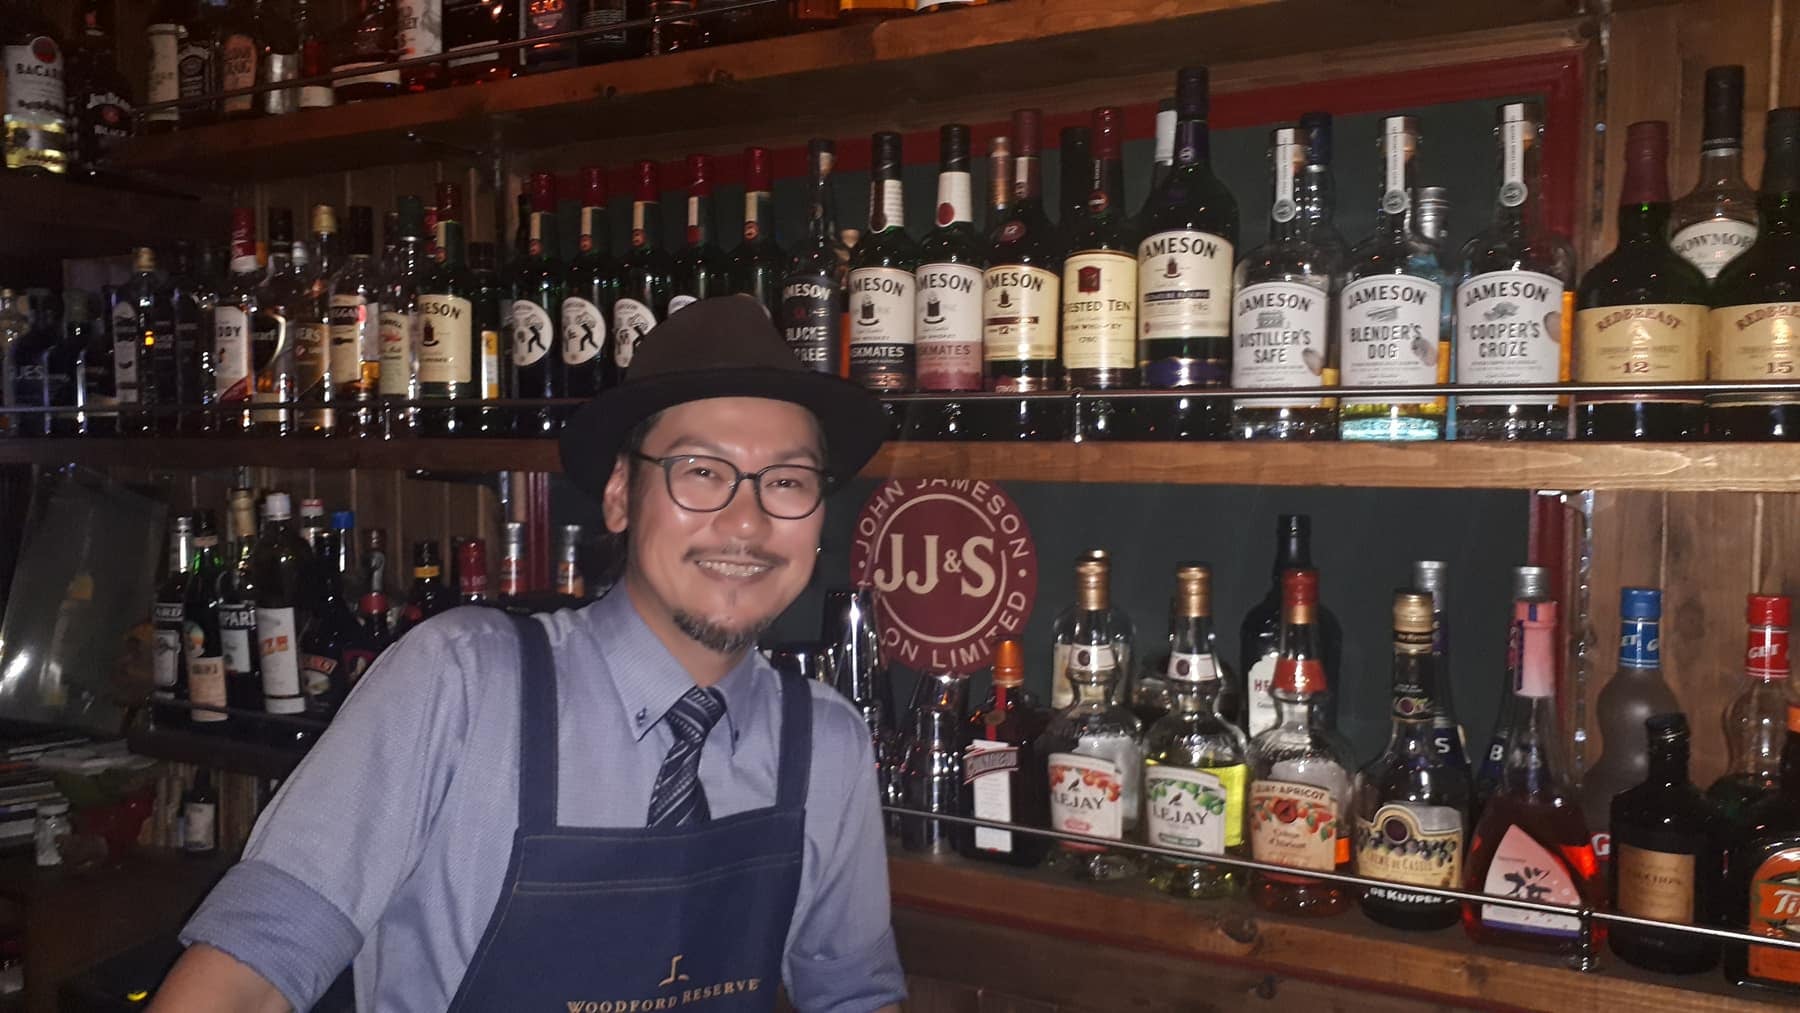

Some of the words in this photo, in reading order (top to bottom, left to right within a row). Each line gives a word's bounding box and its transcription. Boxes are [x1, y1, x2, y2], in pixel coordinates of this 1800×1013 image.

[1106, 299, 1131, 312] TEN
[1239, 293, 1312, 316] JAMESON
[1347, 285, 1428, 309] JAMESON
[1464, 281, 1550, 307] JAMESON
[1596, 307, 1682, 331] REDBREAST
[1351, 323, 1423, 343] BLENDER'S
[1254, 349, 1288, 364] SAFE
[1367, 343, 1400, 360] DOG
[1478, 341, 1529, 358] CROZE
[1622, 361, 1650, 374] 12
[1768, 360, 1794, 374] 15
[856, 480, 905, 555] JOHN
[873, 533, 996, 598] JJ&S
[931, 591, 1027, 670] LIMITED
[567, 996, 679, 1013] WOODFORD
[683, 977, 761, 1004] RESERVE
